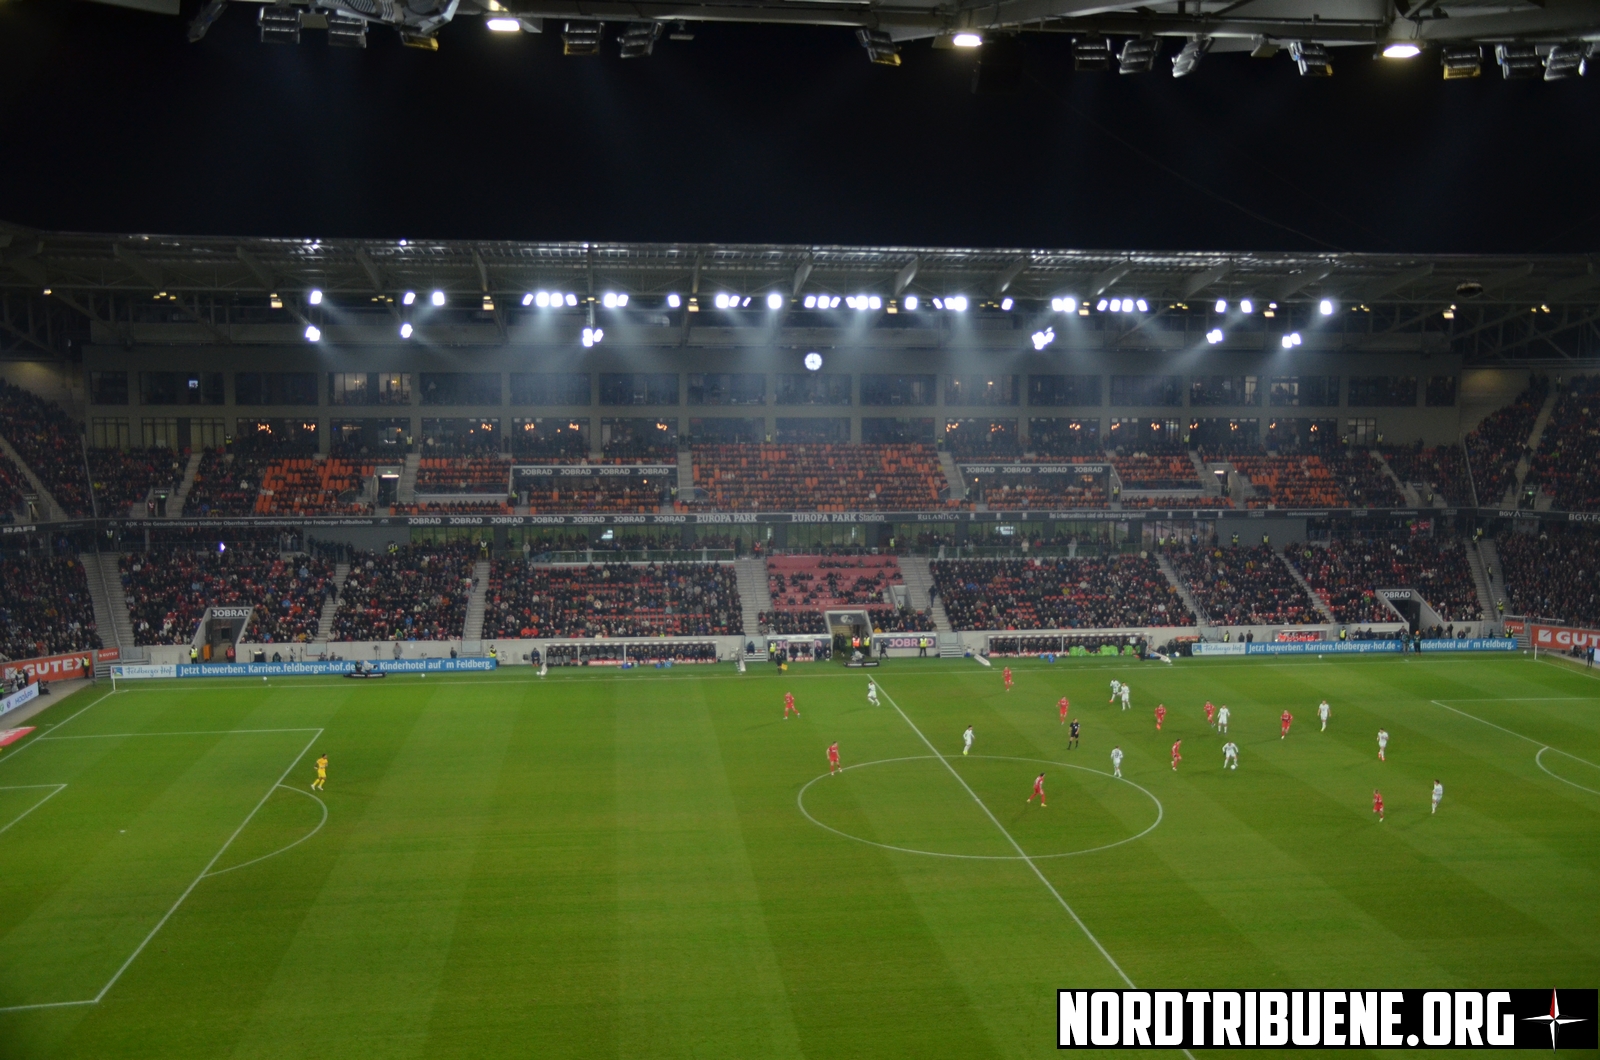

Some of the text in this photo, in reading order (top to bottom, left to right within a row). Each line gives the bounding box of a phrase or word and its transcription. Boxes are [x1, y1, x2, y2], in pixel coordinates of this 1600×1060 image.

[696, 514, 757, 522] EUROPA PARK
[792, 514, 884, 522] EUROPA PARK Stadion
[888, 638, 934, 648] JOBRD
[1248, 644, 1265, 653] Jetzt
[1266, 643, 1303, 652] bewerben:
[1305, 641, 1395, 652] Karriere.feldberger-hof.de
[1420, 640, 1456, 649] inderhotel
[1482, 639, 1514, 650] Feldberg.
[1204, 644, 1244, 654] Feldberger Hof
[125, 664, 174, 676] Feldberger Hof
[180, 662, 355, 676] Jetzt bewerben: Karriere.feldberger-hof.de
[380, 660, 426, 670] Kinderhotel
[457, 660, 492, 670] Feldberg.
